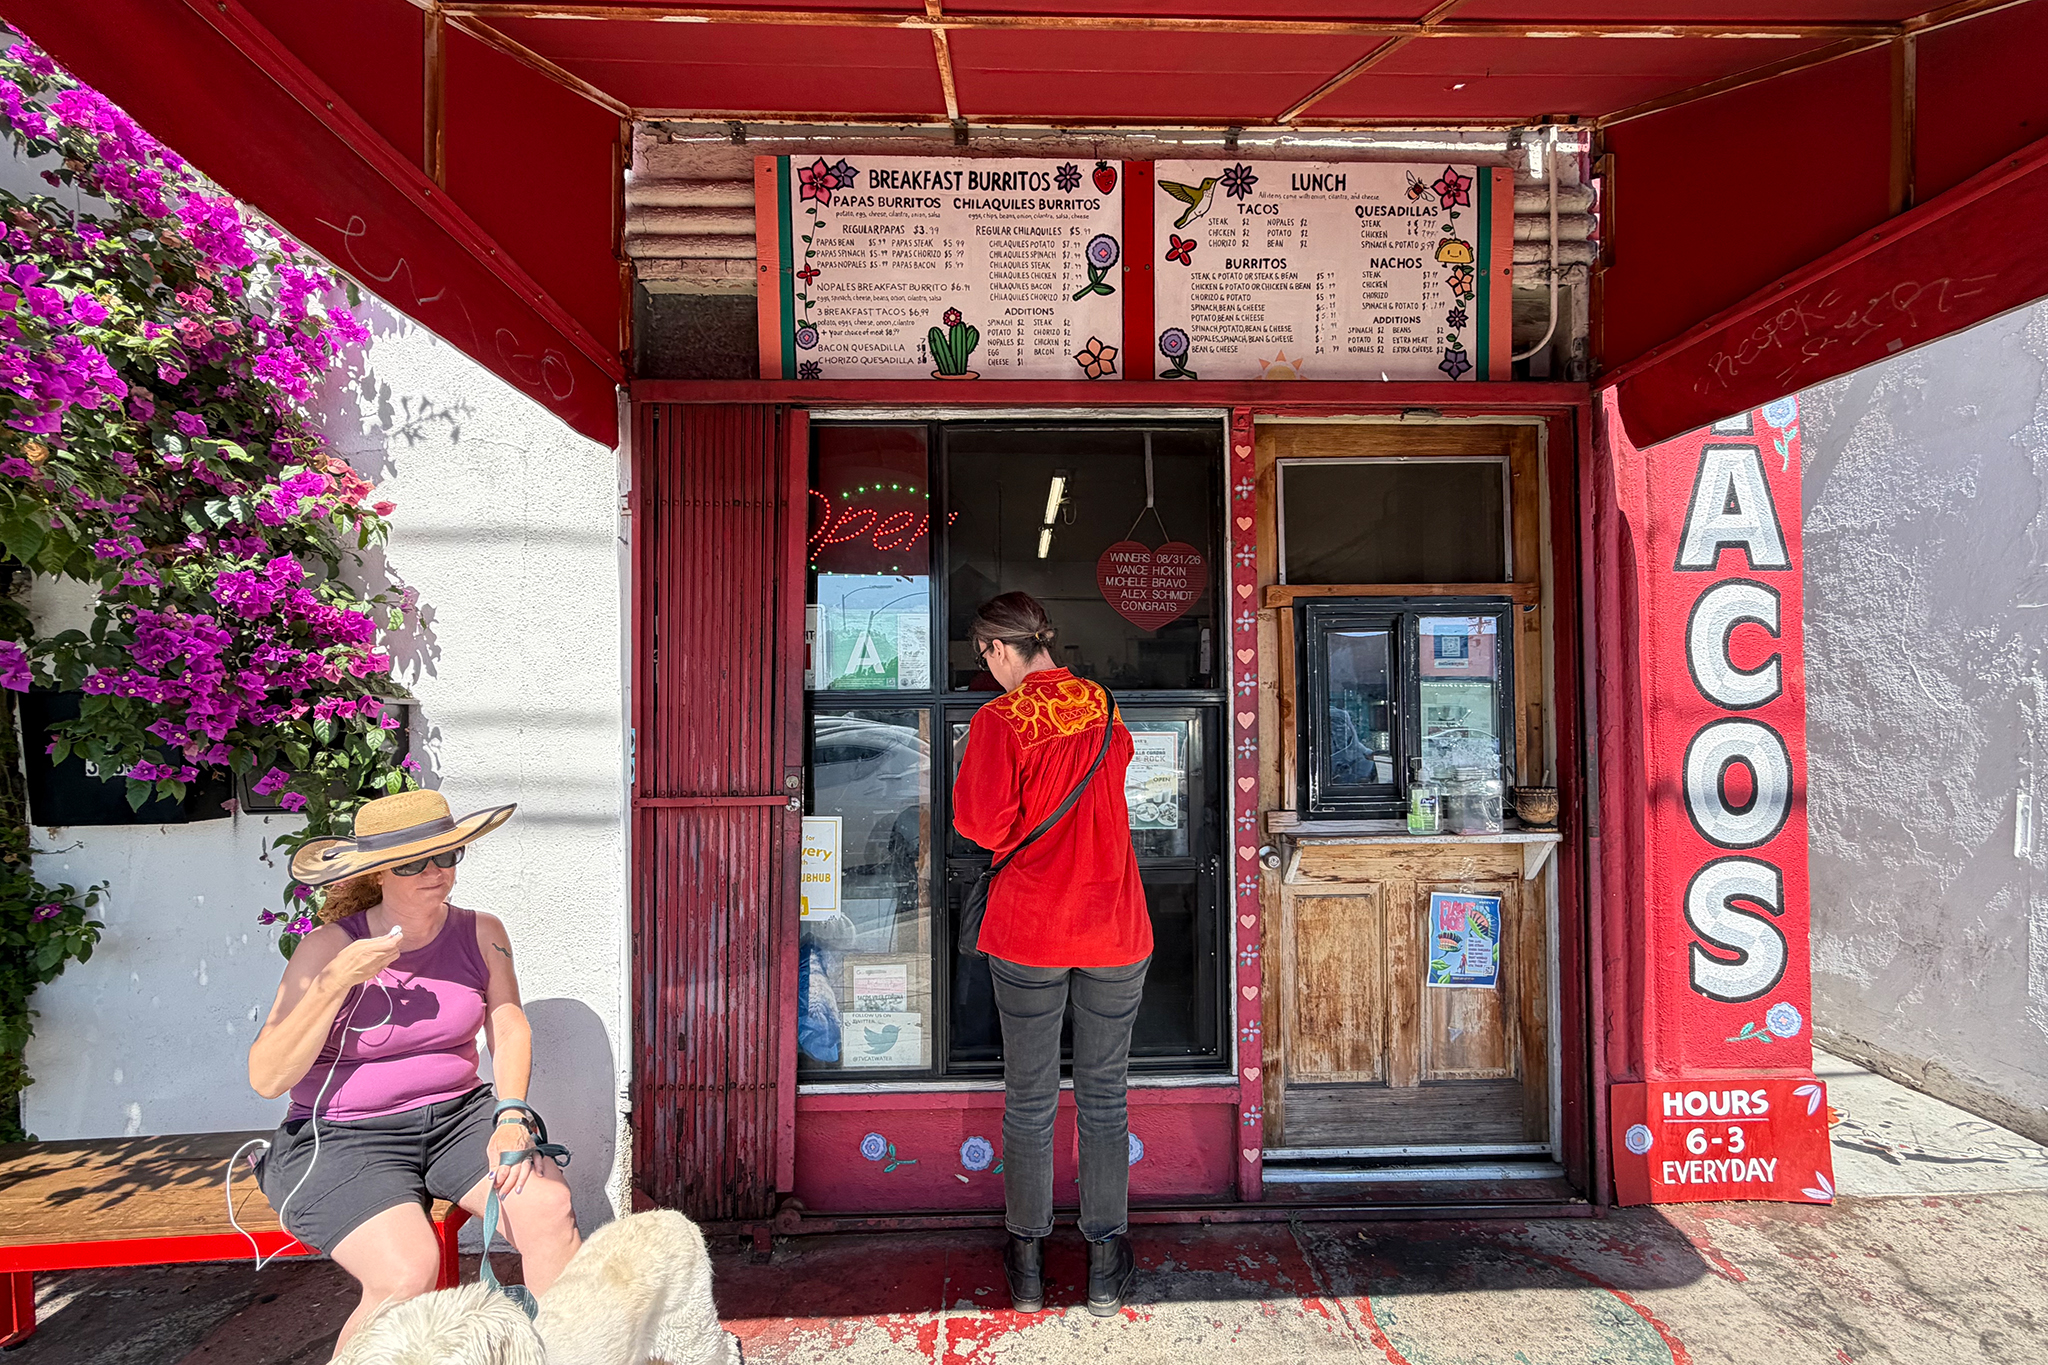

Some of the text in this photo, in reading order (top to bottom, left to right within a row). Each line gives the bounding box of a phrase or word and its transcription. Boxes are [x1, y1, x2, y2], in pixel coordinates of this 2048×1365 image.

[870, 169, 1050, 191] BREAKFAST BURRITOS
[1292, 173, 1346, 191] LUNCH
[834, 196, 941, 208] PAPAS BURRITOS
[953, 198, 1100, 211] CHILAQUILES BURRITOS
[1237, 204, 1279, 215] TACOS
[1355, 205, 1438, 218] QUESADILLAS
[1208, 218, 1250, 226] STEAK $2
[1267, 218, 1308, 226] NOPALES $2
[1361, 220, 1381, 228] STEAK
[843, 224, 904, 234] REGULAR PAPAS
[976, 225, 1062, 236] REGULAR CHILAQUILES
[1208, 229, 1250, 237] CHICKEN $2
[1361, 230, 1388, 238] CHICKEN
[892, 239, 933, 247] PAPAS STEAK
[989, 240, 1055, 248] CHILAQUILES POTATO
[1361, 241, 1387, 249] SPINACH
[892, 250, 941, 258] PAPAS CHORIZO
[989, 251, 1056, 259] CHILAQUILES SPINACH
[892, 261, 912, 269] PAPAS
[989, 261, 1050, 269] CHILAQUILES STEAK
[1226, 258, 1287, 269] BURRITOS
[1370, 258, 1422, 269] NACHOS
[989, 272, 1056, 280] CHILAQUILES CHICKEN
[1281, 272, 1298, 280] BEAN
[817, 283, 947, 291] NOPALES BREAKFAST BURRITO
[990, 283, 1052, 291] CHILAQUILES BACON
[1261, 282, 1288, 290] CHICKEN
[1295, 282, 1311, 290] BEAN
[990, 293, 1058, 301] CHILAQUILES CHORIZO
[1191, 293, 1251, 301] CHORIZO POTATO
[1362, 302, 1418, 310] SPINACH POTATO
[824, 308, 874, 316] BREAKFAST
[877, 308, 906, 316] TACOS
[1005, 308, 1054, 316] ADDITIONS
[1241, 314, 1264, 322] CHEESE
[1373, 316, 1421, 324] ADDITIONS
[1034, 328, 1060, 336] CHORIZO
[1034, 338, 1059, 346] CHICKEN
[851, 344, 905, 352] QUESADILLA
[1215, 345, 1238, 353] CHEESE
[860, 356, 914, 364] QUESADILLA
[988, 358, 1009, 366] CHEESE
[1110, 553, 1201, 565] WINNERS 08/31/26
[1116, 565, 1186, 576] VANCE HICKIN
[1106, 577, 1187, 588] MICHELE BRAVO
[1121, 590, 1194, 600] ALEX SCHMIDT
[1121, 601, 1177, 611] CONGRATS
[845, 631, 885, 673] A
[1663, 1089, 1769, 1117] HOURS
[1663, 1158, 1777, 1184] EVERYDAY
